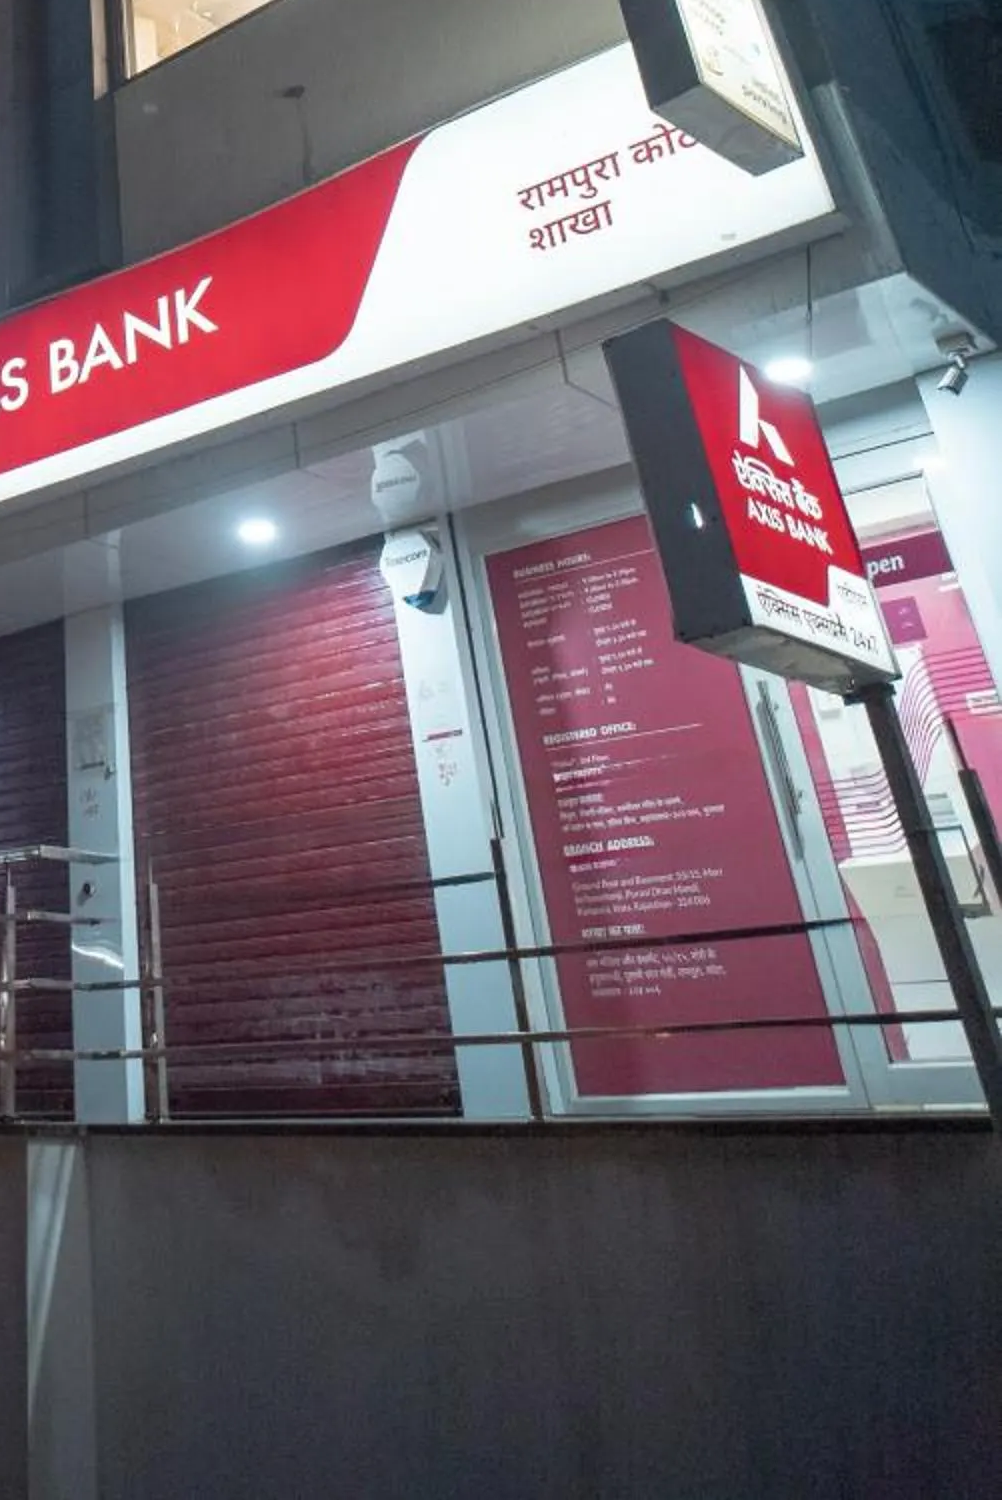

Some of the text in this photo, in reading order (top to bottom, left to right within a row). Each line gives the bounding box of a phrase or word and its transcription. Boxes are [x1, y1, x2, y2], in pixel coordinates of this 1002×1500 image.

[517, 124, 698, 210] रामपुरा कोट
[529, 200, 613, 251] शाखा
[49, 276, 219, 394] BANK
[747, 497, 834, 555] AXIS BANK
[866, 554, 905, 583] pen
